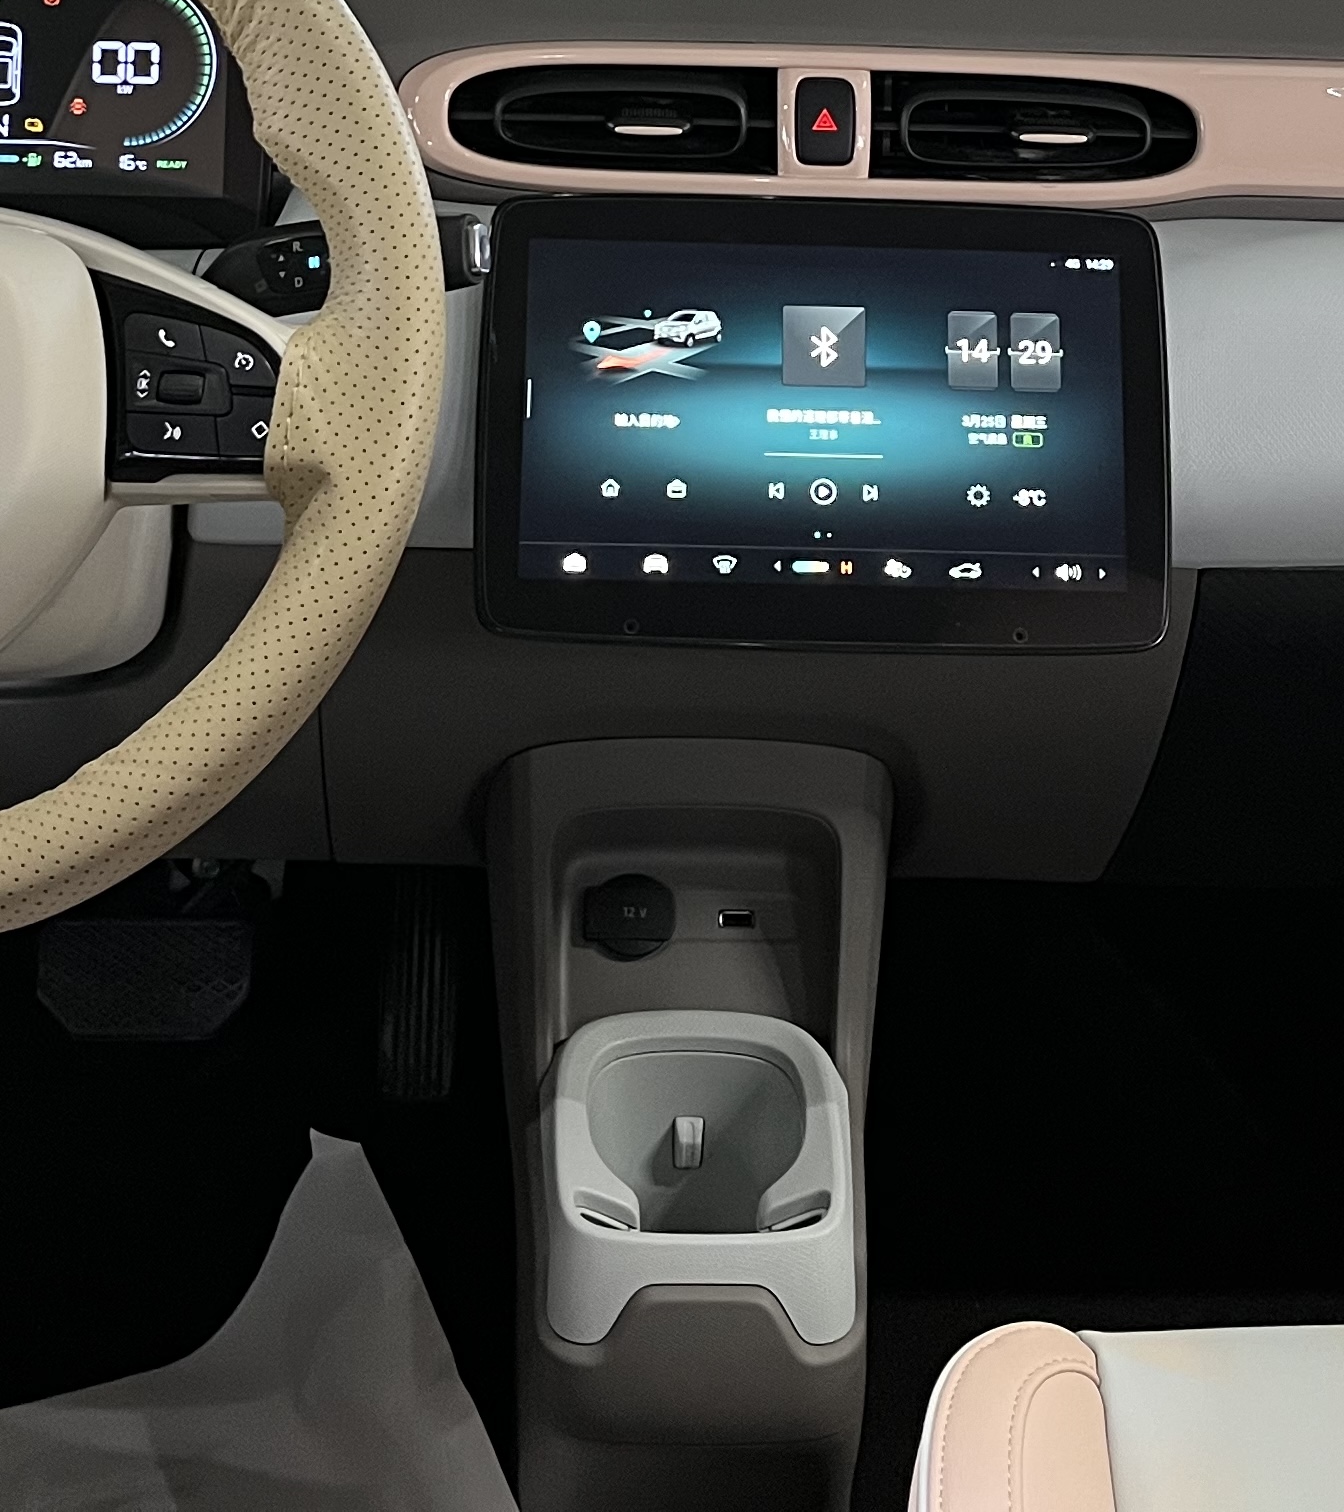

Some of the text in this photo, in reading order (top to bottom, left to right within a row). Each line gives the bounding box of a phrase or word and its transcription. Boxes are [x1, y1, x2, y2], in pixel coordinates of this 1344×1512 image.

[92, 40, 161, 85] 00
[156, 160, 188, 169] READY
[293, 241, 303, 252] R
[294, 277, 304, 288] D
[956, 338, 991, 363] 14
[1018, 339, 1053, 365] 29
